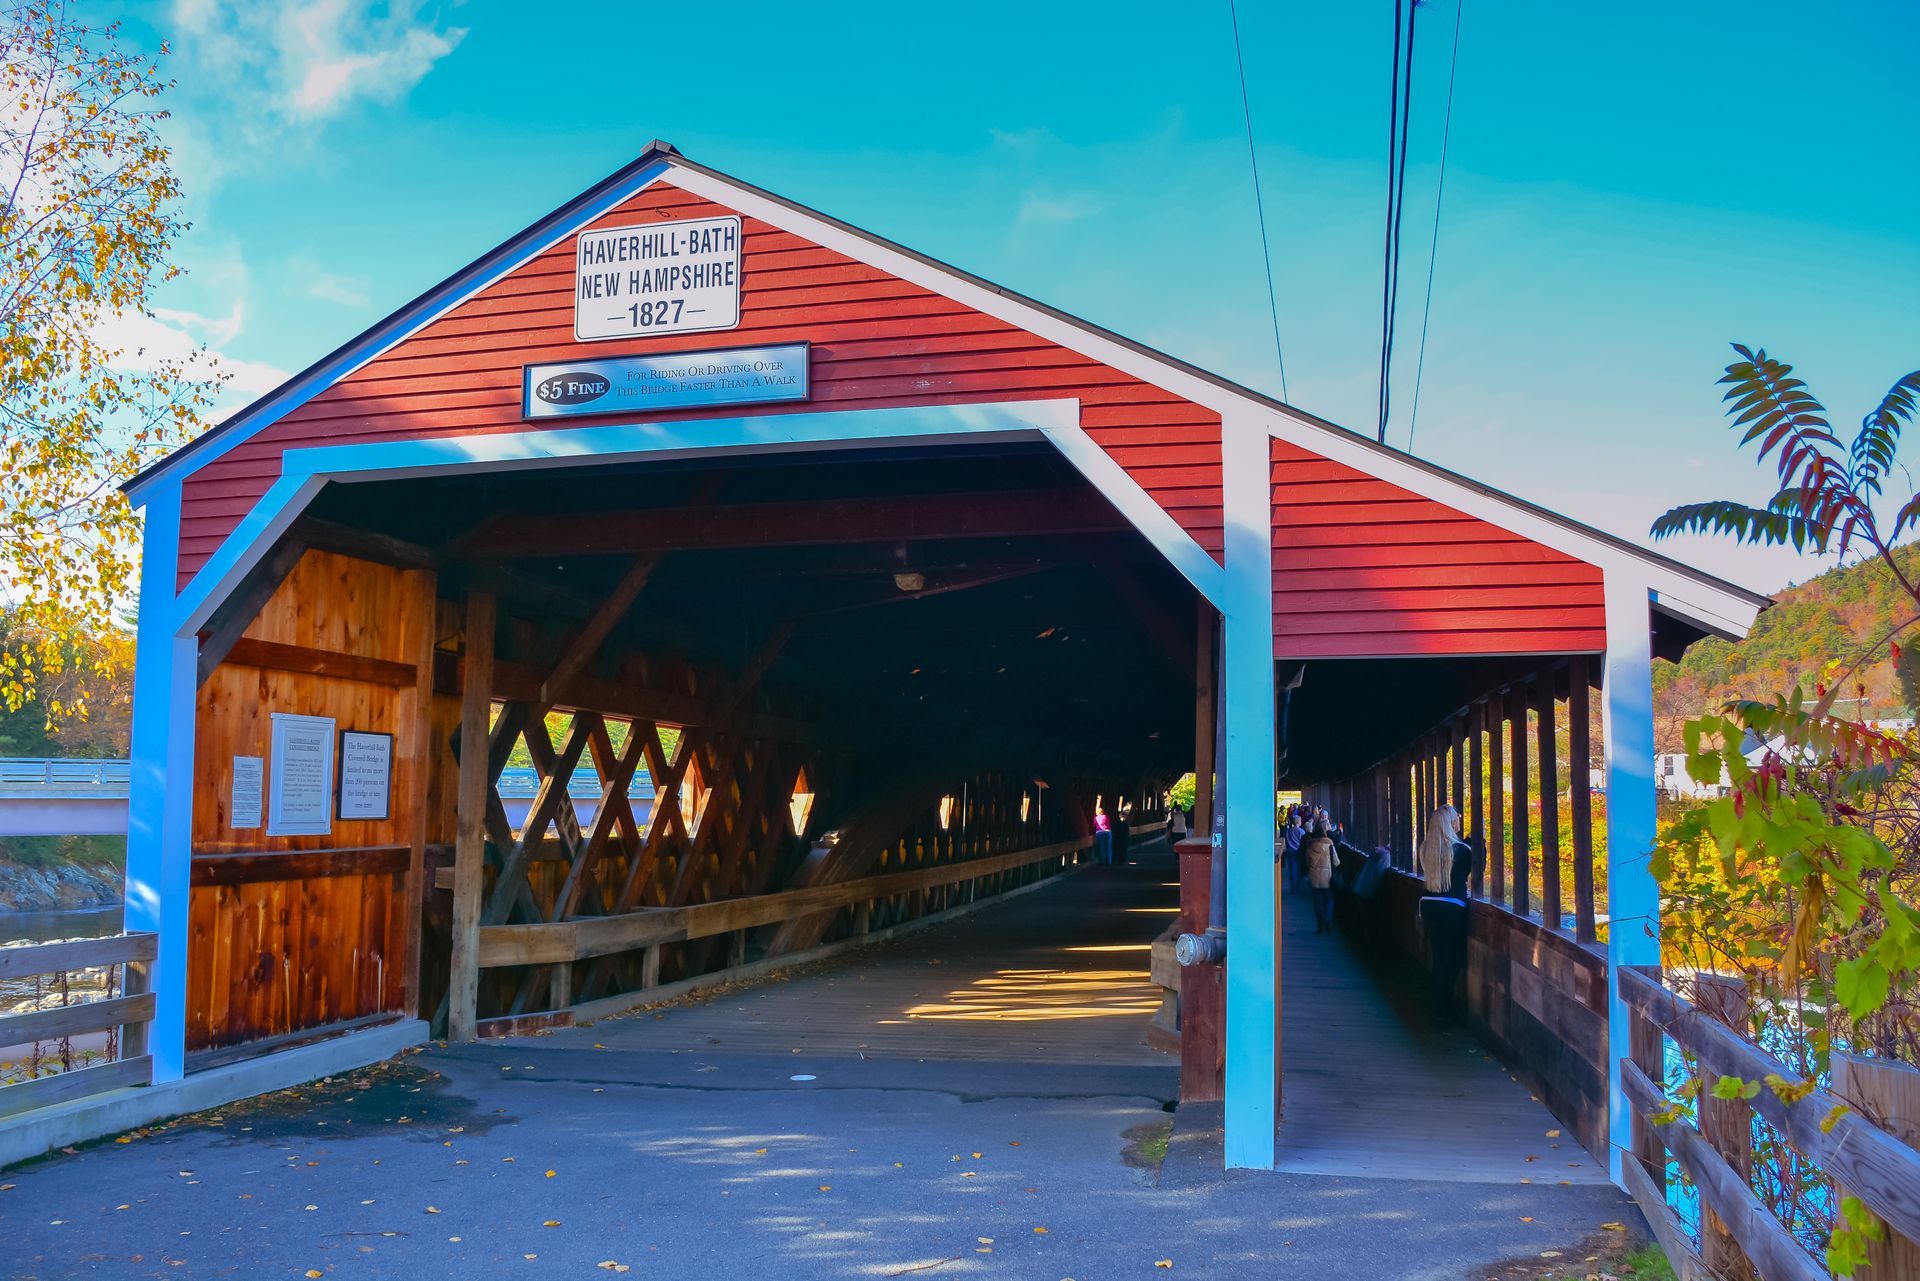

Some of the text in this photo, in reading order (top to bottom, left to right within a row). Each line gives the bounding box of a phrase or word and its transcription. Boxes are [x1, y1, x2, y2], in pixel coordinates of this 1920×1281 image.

[583, 226, 735, 266] HAVERHILL-BATH
[582, 261, 734, 300] NEW HAMPSHIRE
[540, 380, 605, 400] $5 FINE
[752, 378, 761, 387] A
